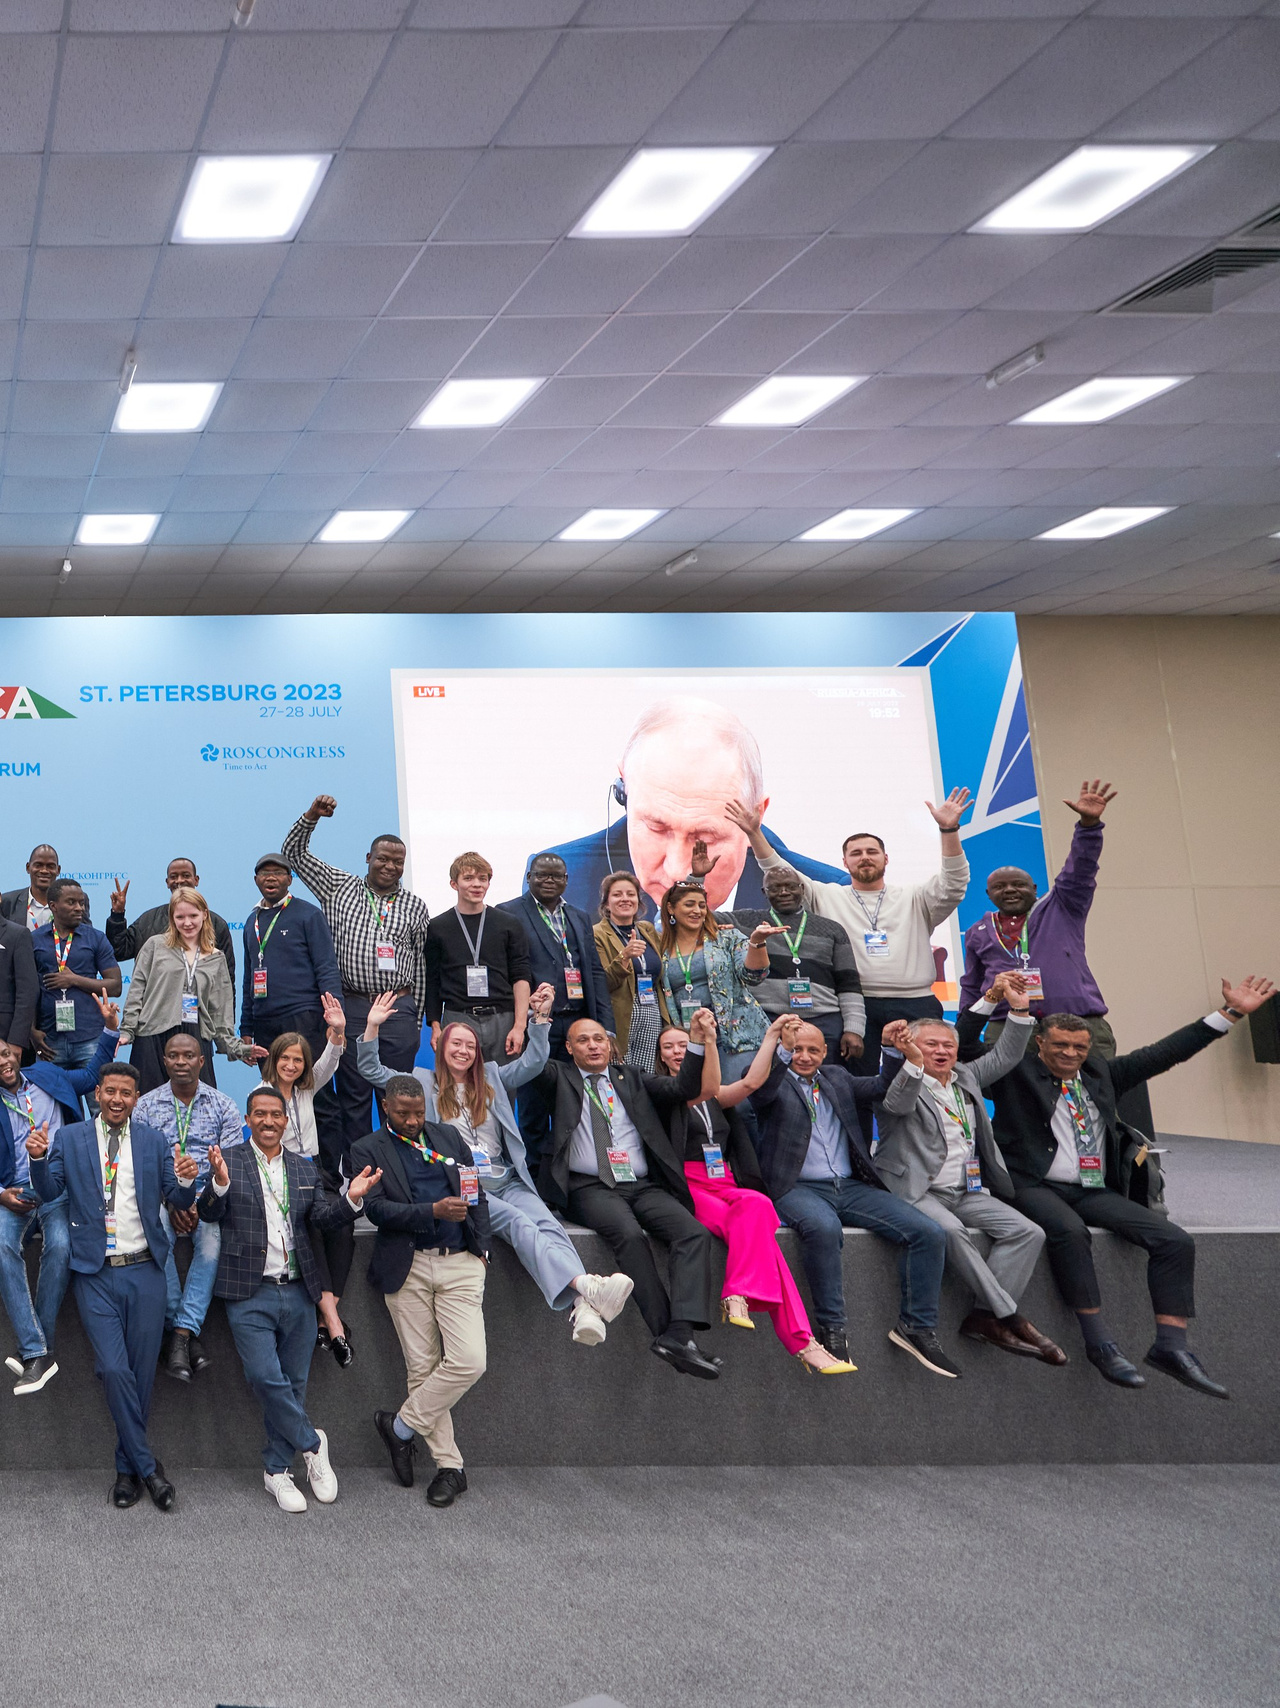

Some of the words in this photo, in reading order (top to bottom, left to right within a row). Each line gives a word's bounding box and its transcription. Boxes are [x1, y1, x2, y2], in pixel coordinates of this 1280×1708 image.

[79, 685, 113, 702] ST.
[120, 684, 277, 702] PETERSBURG
[283, 683, 342, 700] 2023
[418, 687, 440, 697] LIVE
[308, 706, 342, 717] JULY
[869, 708, 900, 718] 19:52
[222, 746, 345, 759] ROSCONGRESS
